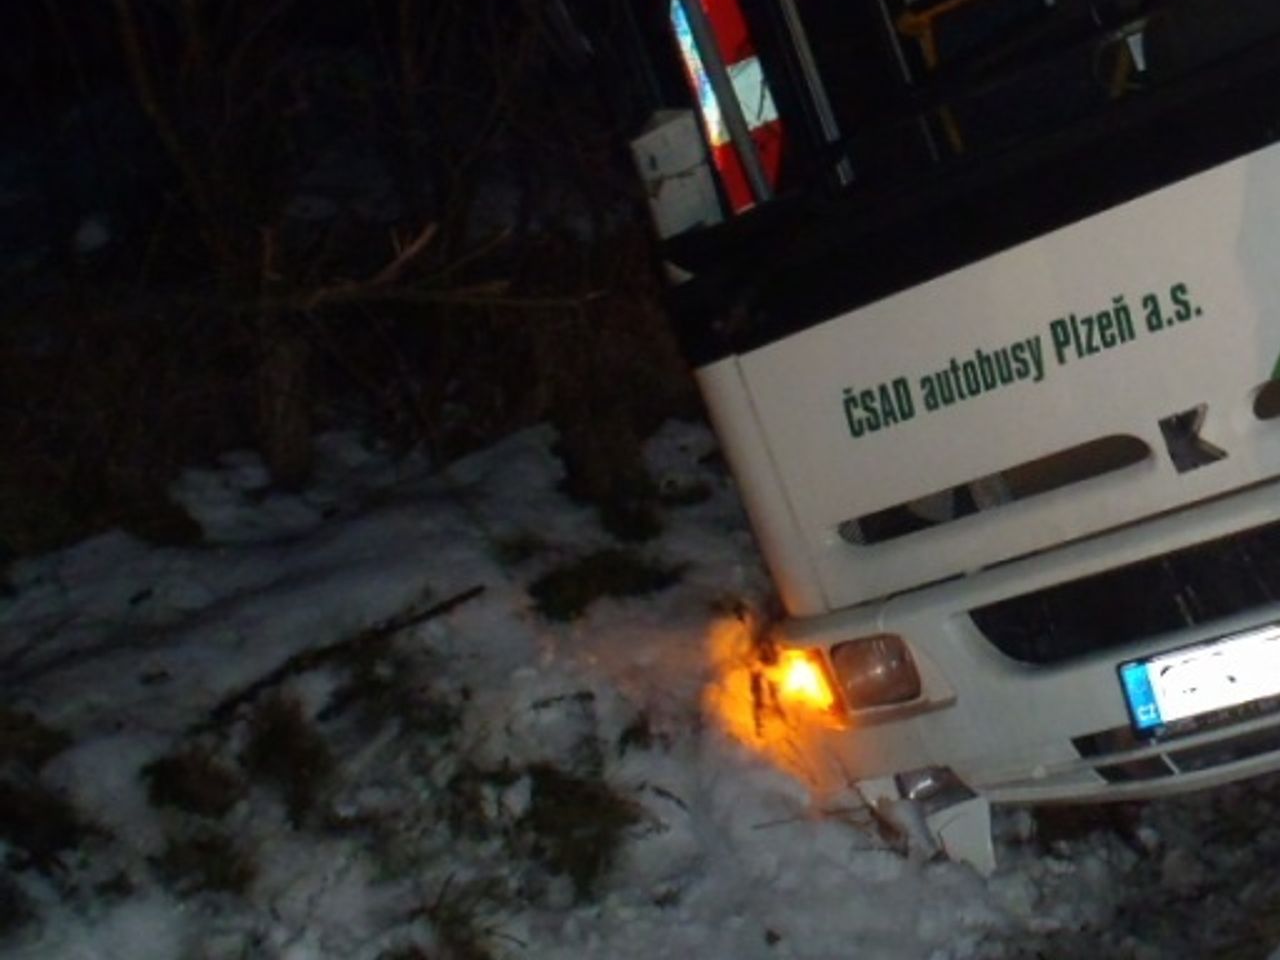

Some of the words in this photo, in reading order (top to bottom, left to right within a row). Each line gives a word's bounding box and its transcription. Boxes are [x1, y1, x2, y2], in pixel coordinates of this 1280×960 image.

[841, 374, 917, 440] ČSAD
[919, 334, 1046, 414] autobusy
[1048, 294, 1137, 366] Plzeň
[1141, 282, 1204, 334] a.s.
